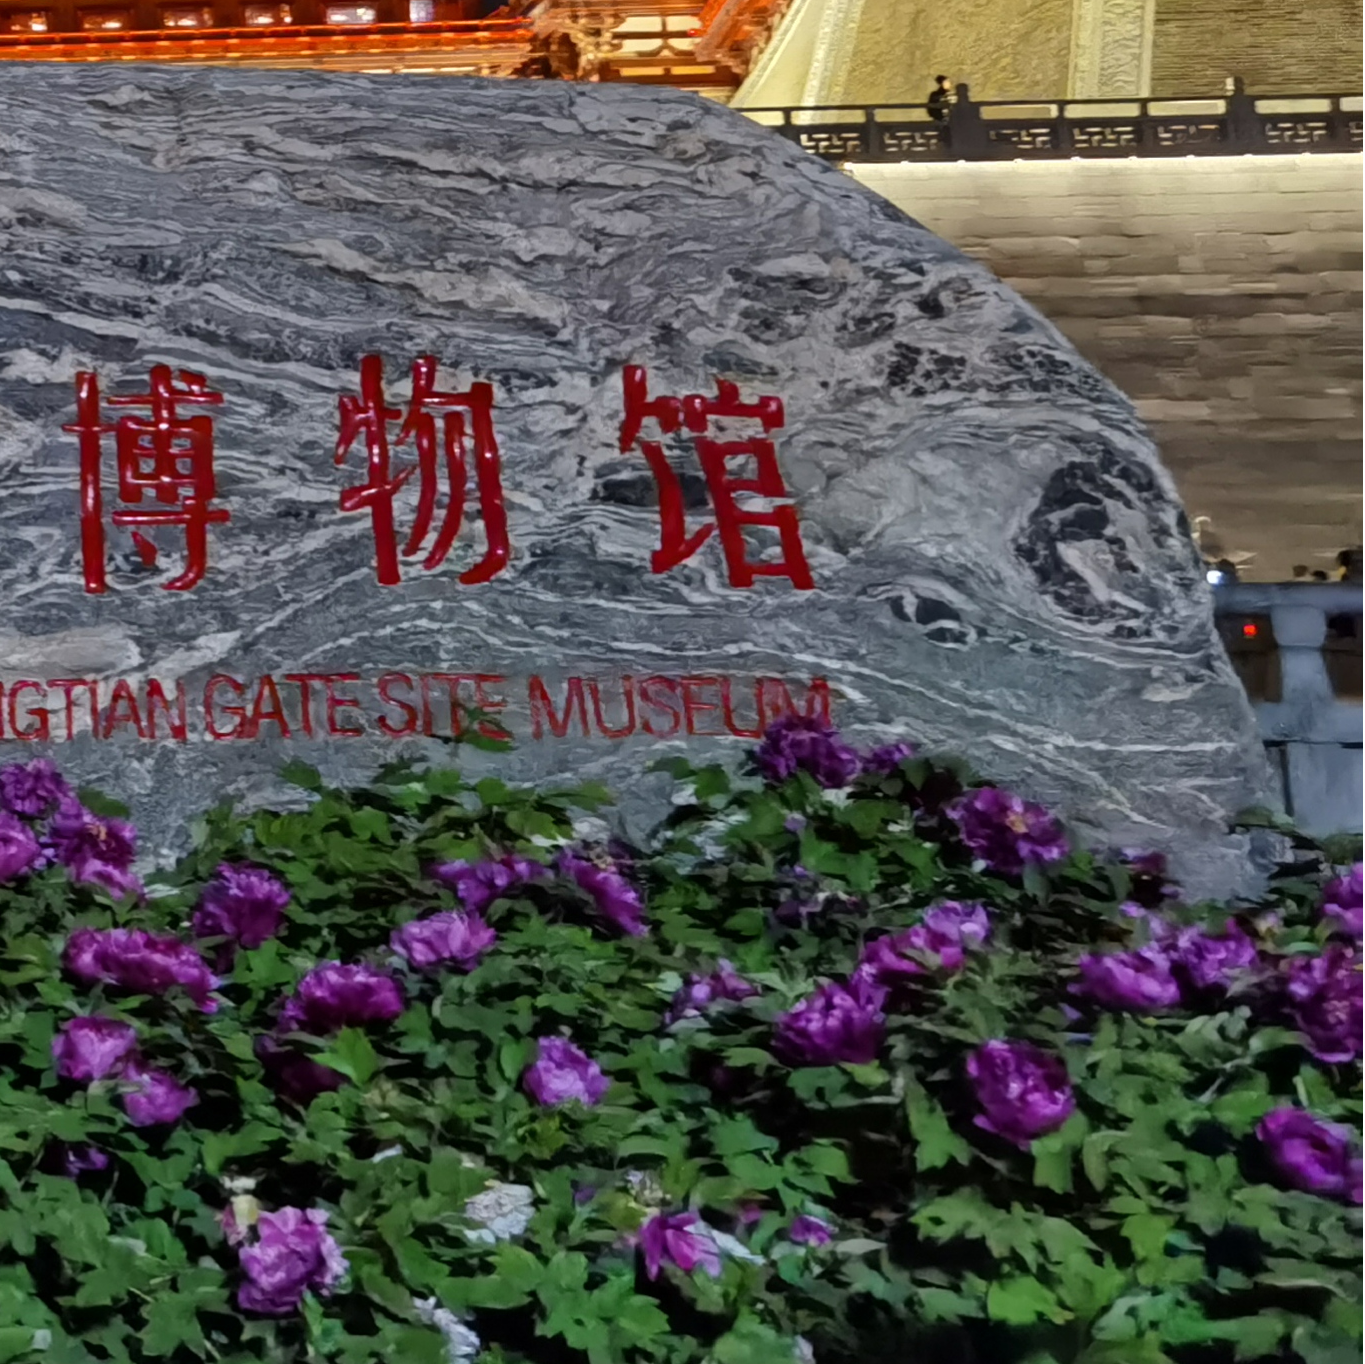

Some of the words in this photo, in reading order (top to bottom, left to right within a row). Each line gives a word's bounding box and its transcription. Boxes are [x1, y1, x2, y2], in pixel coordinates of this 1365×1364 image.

[203, 672, 362, 742] GATE
[376, 671, 513, 739] SITE
[528, 674, 833, 740] MUSEUM
